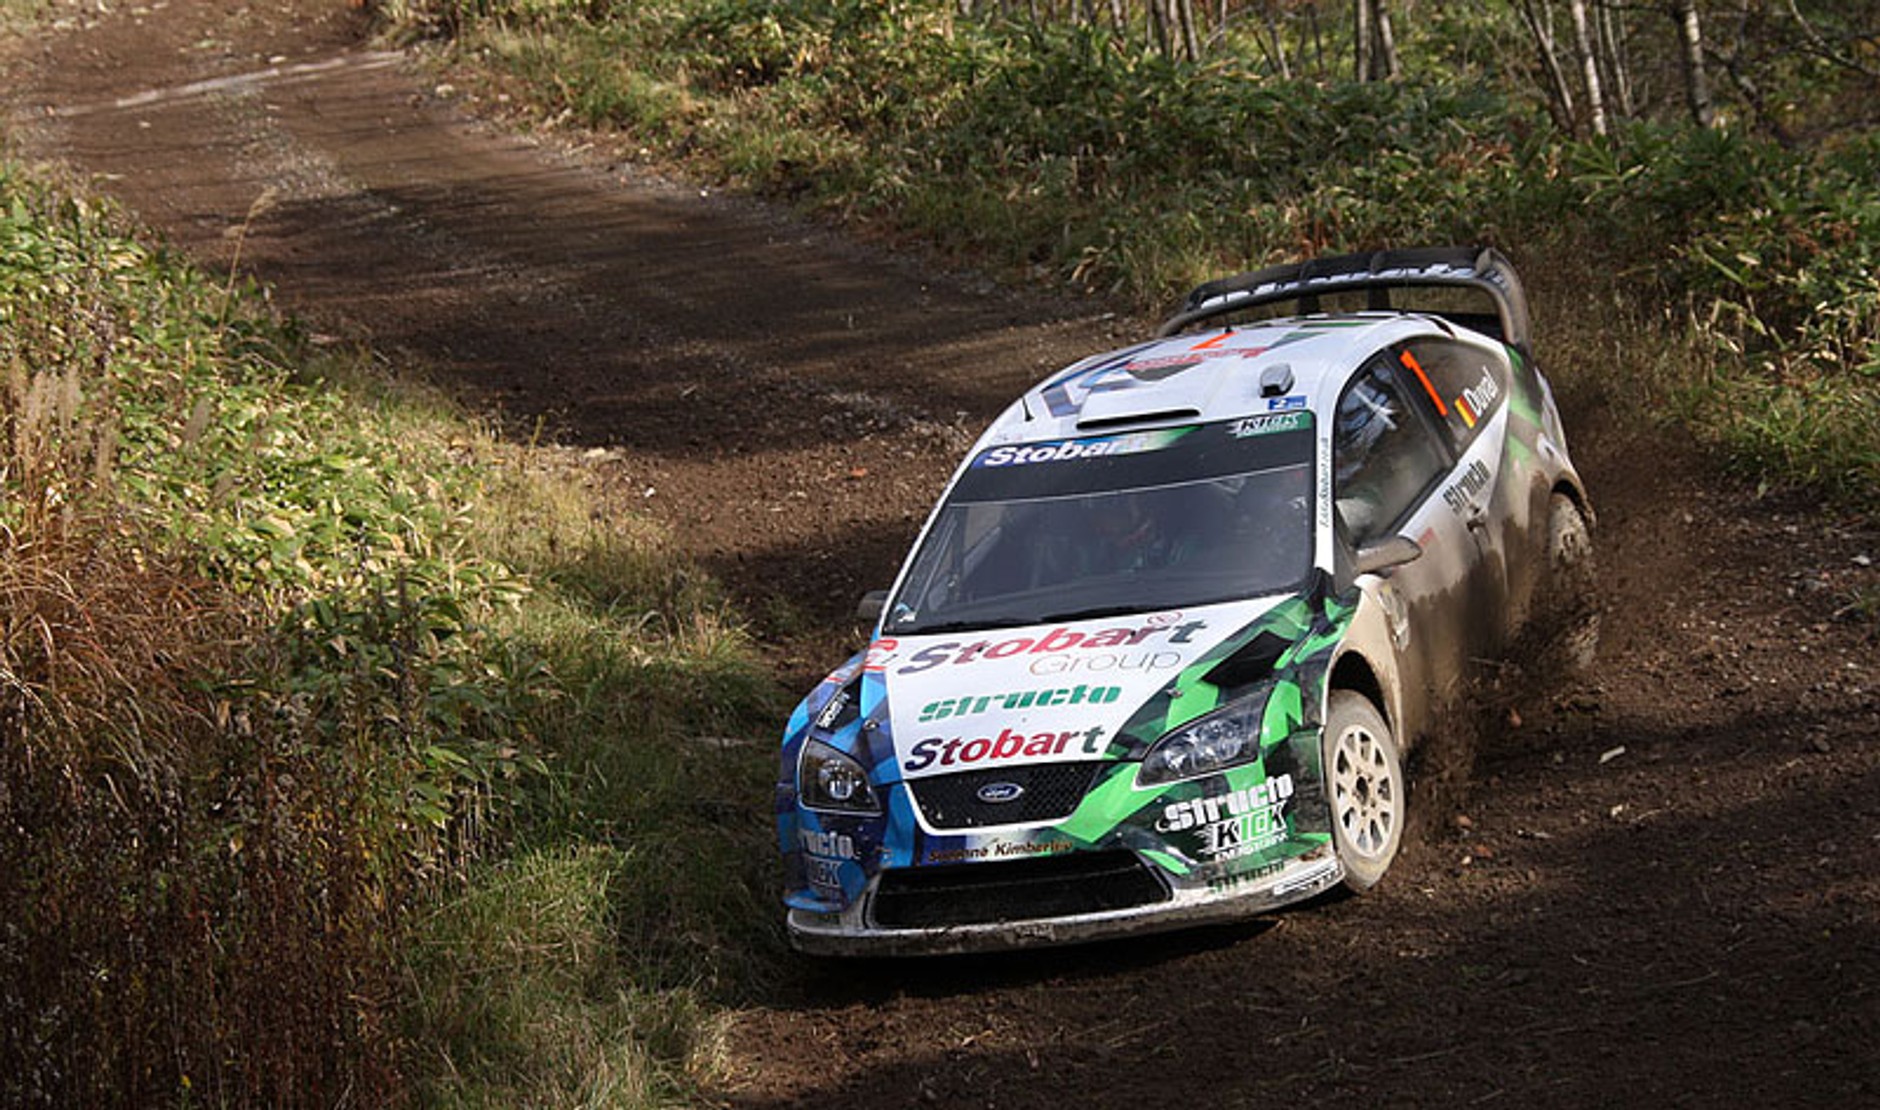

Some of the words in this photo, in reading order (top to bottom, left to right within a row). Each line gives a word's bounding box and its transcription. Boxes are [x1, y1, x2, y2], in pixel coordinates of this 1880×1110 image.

[1462, 365, 1498, 417] Duval
[897, 619, 1206, 675] Stobart
[1029, 648, 1181, 676] Group
[904, 726, 1105, 771] Stobart
